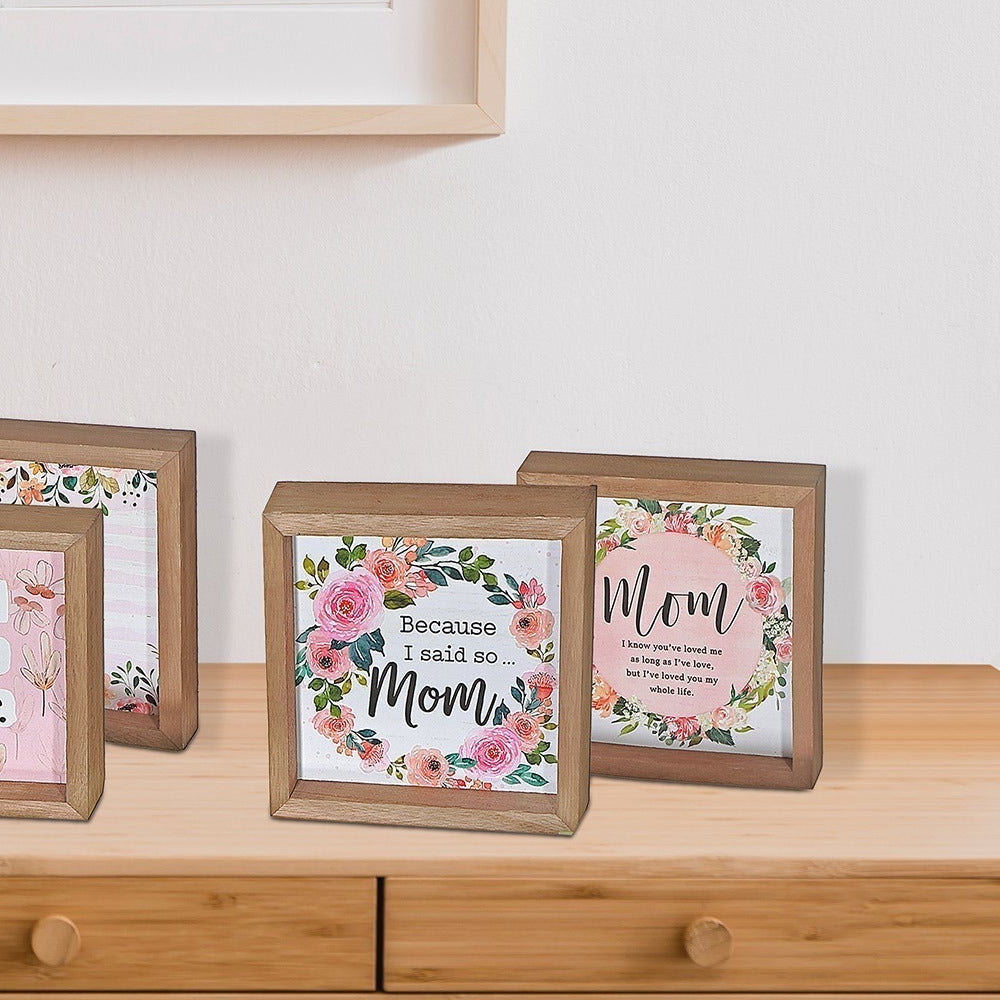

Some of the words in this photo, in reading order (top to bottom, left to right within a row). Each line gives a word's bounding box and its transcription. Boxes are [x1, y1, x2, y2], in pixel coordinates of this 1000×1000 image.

[603, 564, 744, 637] Mom
[399, 615, 496, 636] Because
[404, 645, 413, 661] I
[420, 645, 466, 663] said
[622, 640, 626, 648] I
[628, 641, 651, 650] know
[653, 643, 682, 652] you've
[684, 645, 707, 654] loved
[642, 656, 660, 665] long
[674, 658, 691, 667] I've
[693, 660, 714, 670] love,
[626, 669, 640, 677] but
[643, 670, 659, 679] I've
[661, 672, 685, 681] loved
[705, 677, 718, 686] my
[368, 662, 497, 728] Mom
[650, 685, 675, 694] whole
[677, 687, 694, 696] life.
